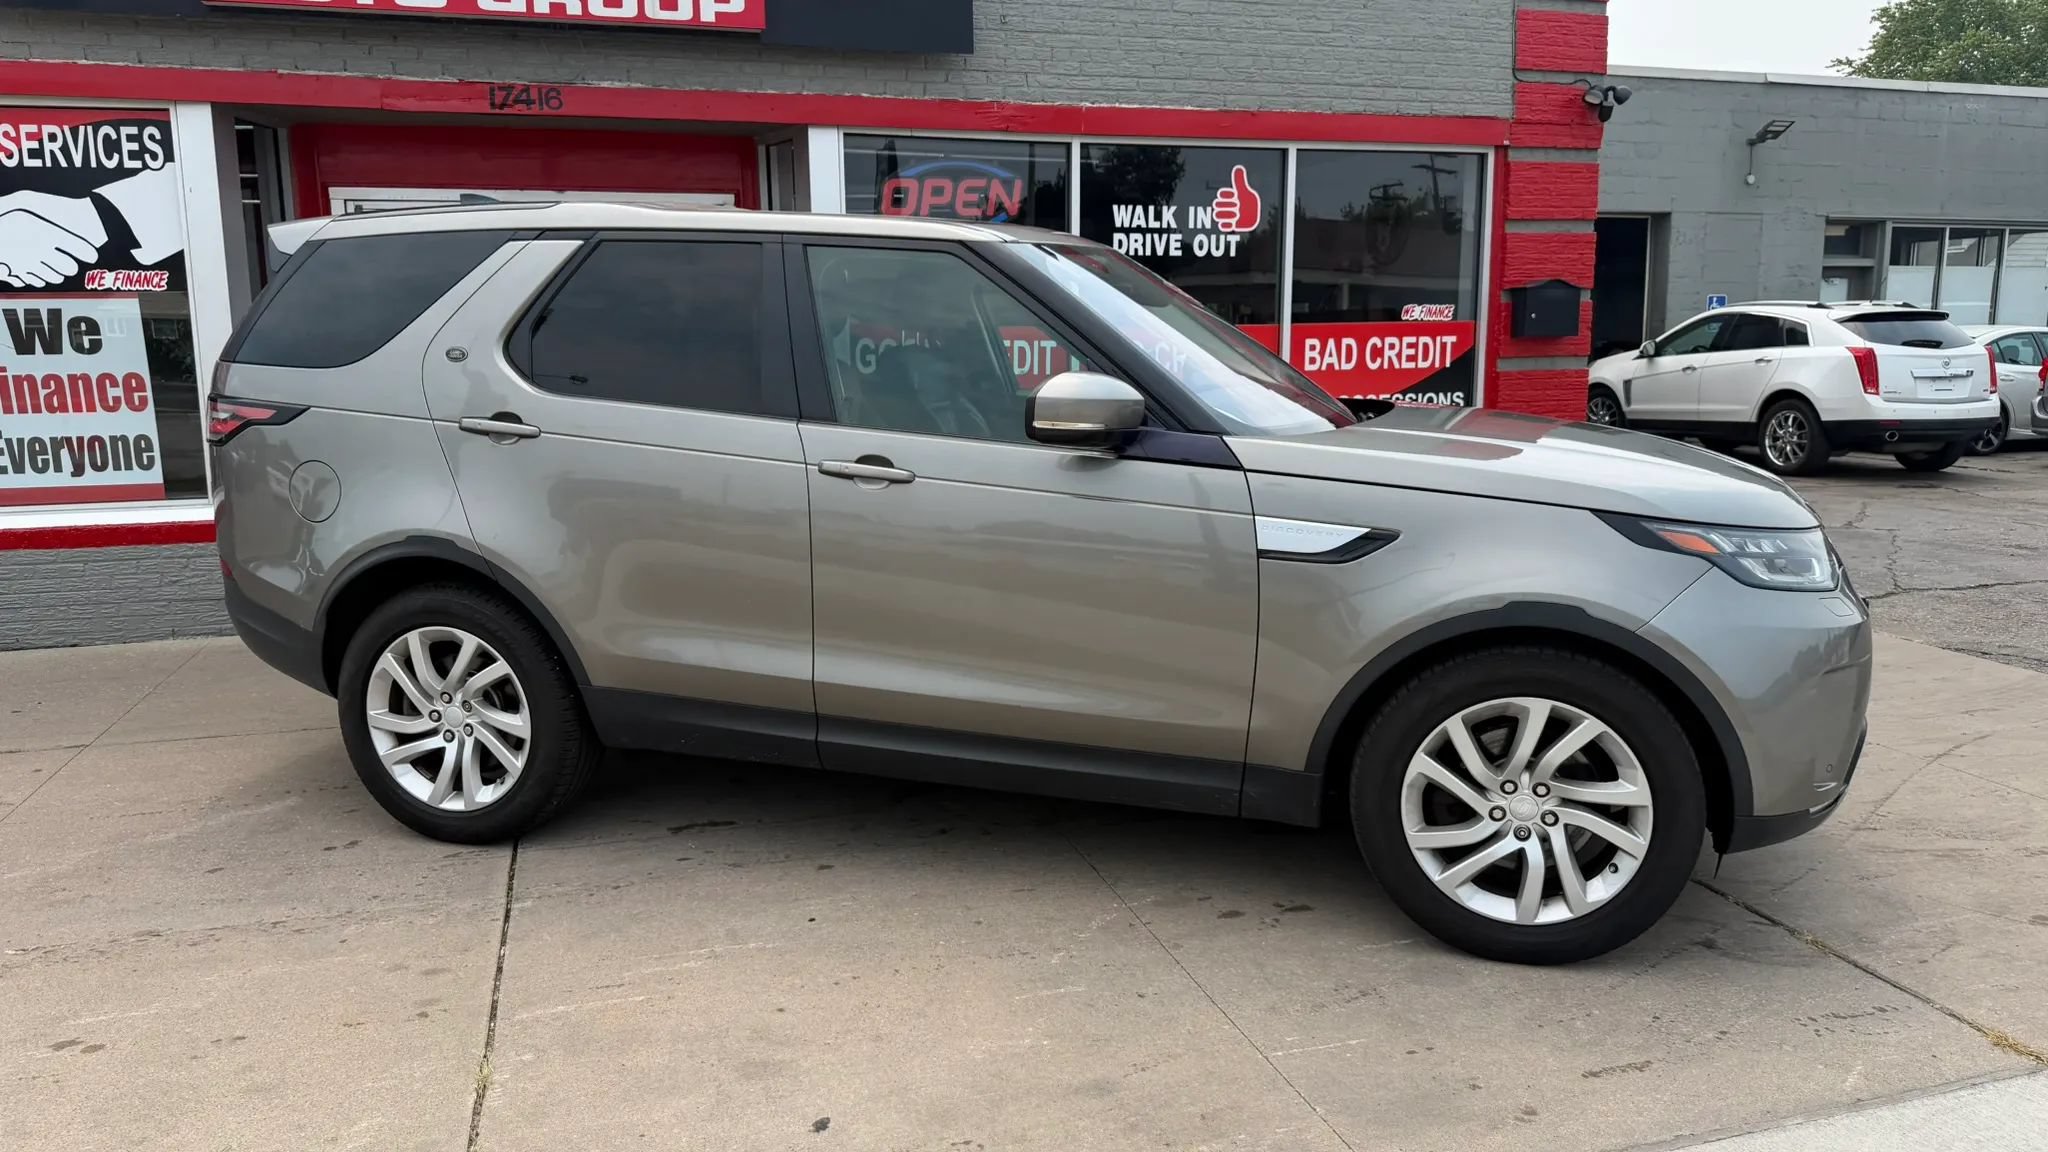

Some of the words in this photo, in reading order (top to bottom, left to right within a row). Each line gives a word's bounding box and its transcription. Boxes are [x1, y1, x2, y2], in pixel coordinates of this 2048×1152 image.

[489, 85, 563, 111] 17416
[0, 123, 164, 170] SERVICES
[880, 177, 1023, 217] OPEN
[1112, 204, 1177, 229] WALK
[1189, 205, 1212, 230] IN
[1113, 233, 1182, 257] DRIVE
[1193, 234, 1240, 257] OUT
[85, 269, 107, 289] WE
[112, 270, 168, 291] FINANCE
[1401, 304, 1417, 320] WE
[1418, 304, 1455, 321] FINANCE
[2, 308, 103, 356] We
[1304, 337, 1358, 372] BAD
[1365, 335, 1457, 371] CREDIT
